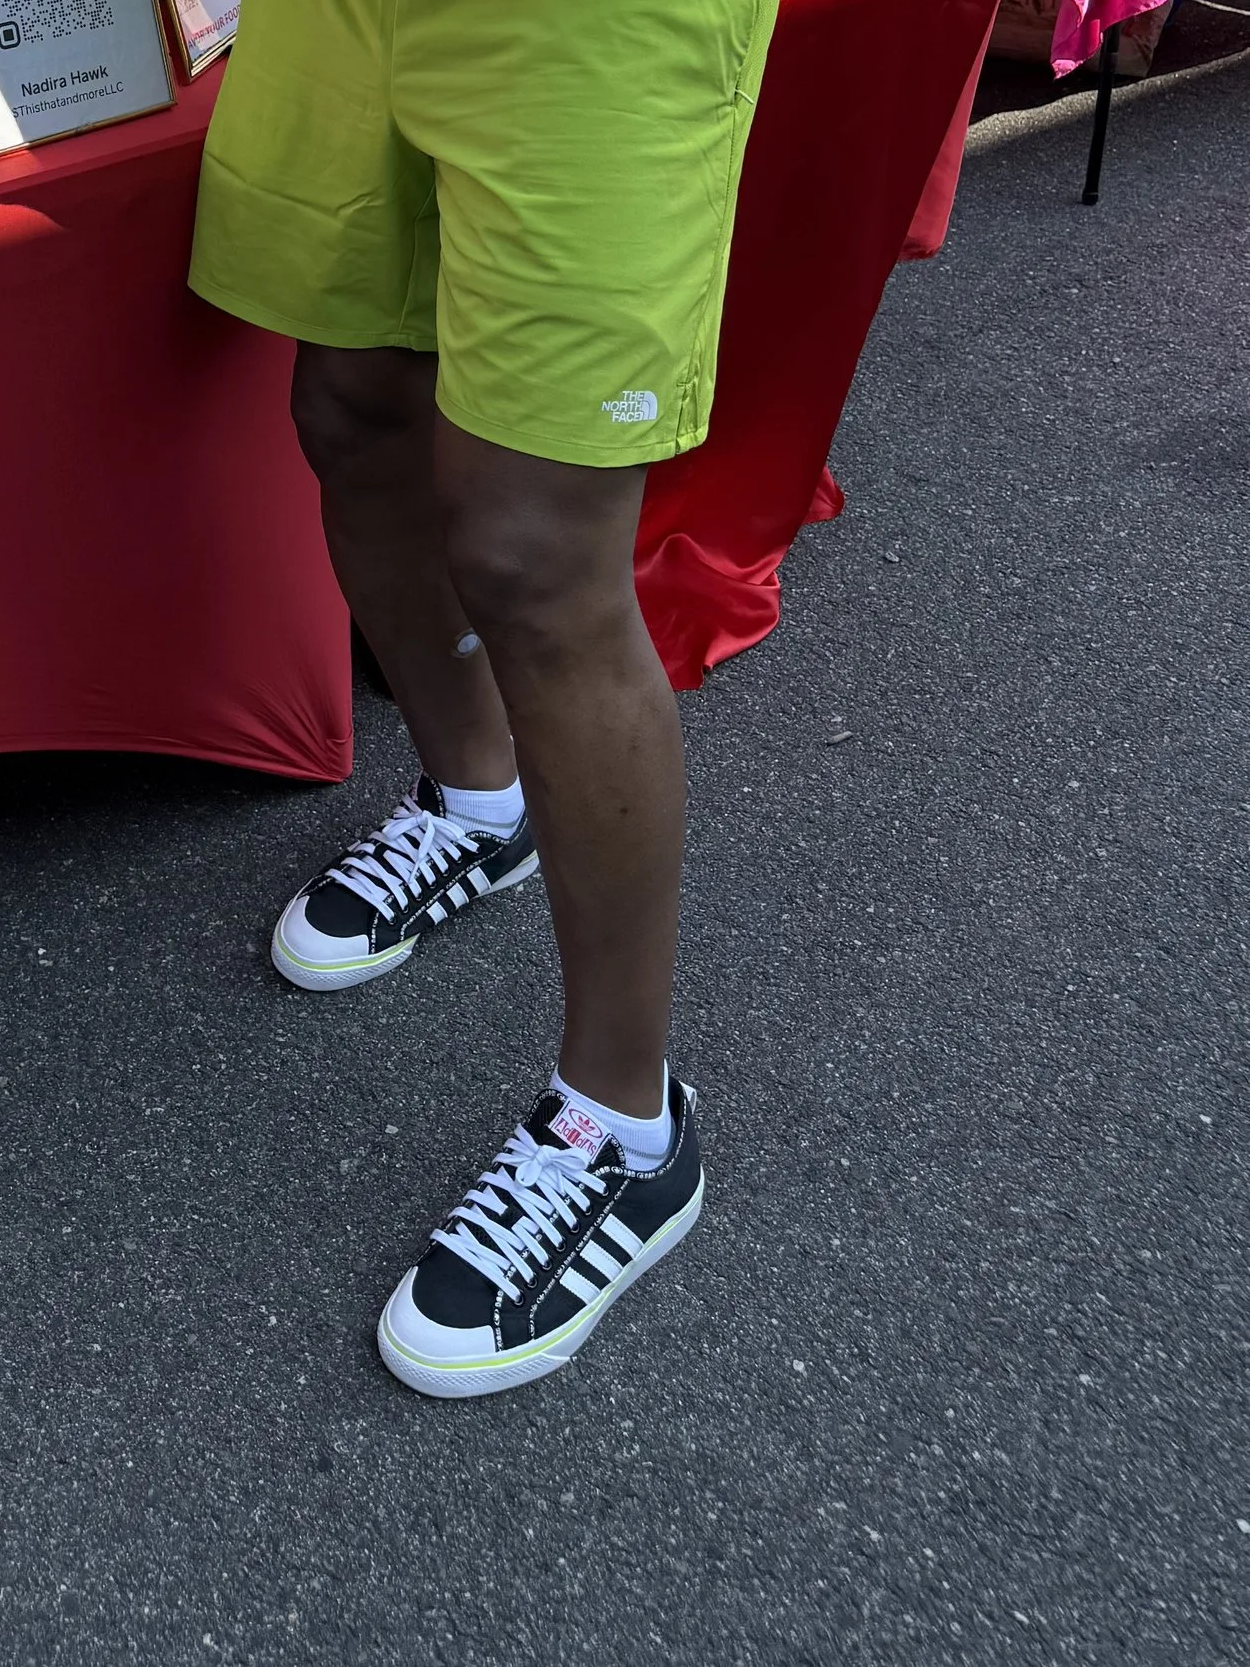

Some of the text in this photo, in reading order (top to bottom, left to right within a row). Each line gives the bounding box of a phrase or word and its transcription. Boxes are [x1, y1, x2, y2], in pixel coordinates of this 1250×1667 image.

[21, 65, 109, 97] Nadira Hawk
[622, 390, 644, 401] THE
[602, 401, 642, 412] NORTH
[612, 411, 641, 422] FACE
